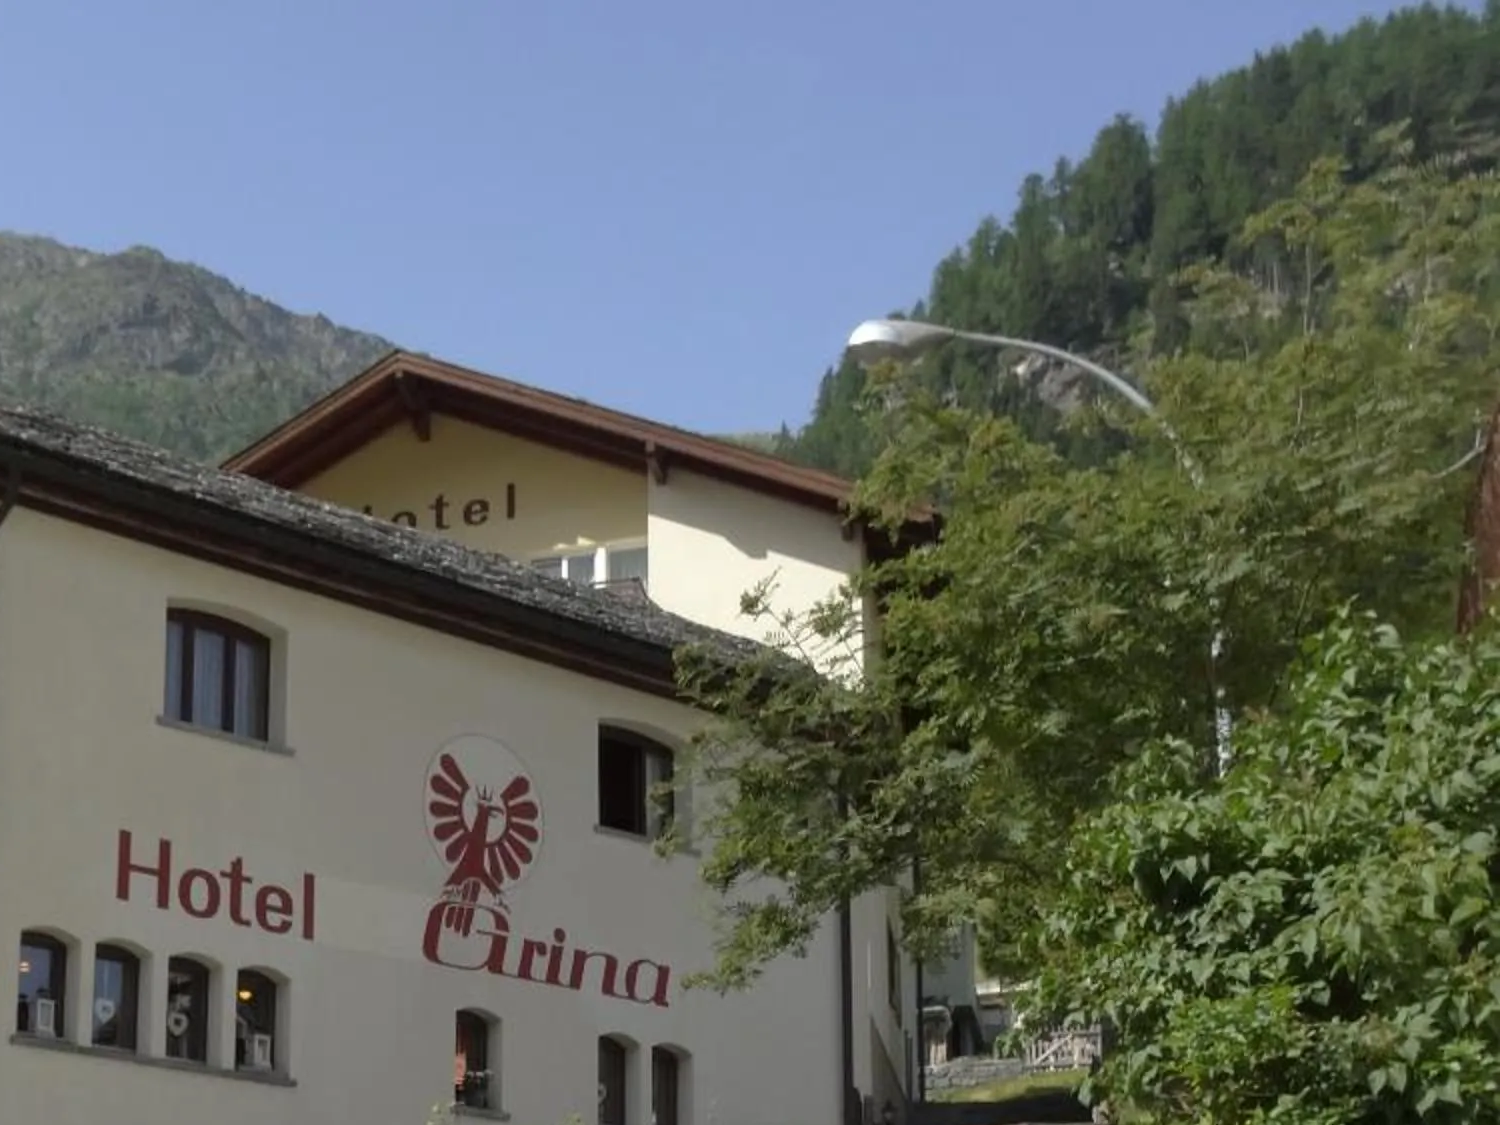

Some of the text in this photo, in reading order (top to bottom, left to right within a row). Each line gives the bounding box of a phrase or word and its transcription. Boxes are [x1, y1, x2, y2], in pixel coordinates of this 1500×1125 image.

[362, 482, 516, 531] otel
[116, 828, 670, 1008] Hotel Grina
